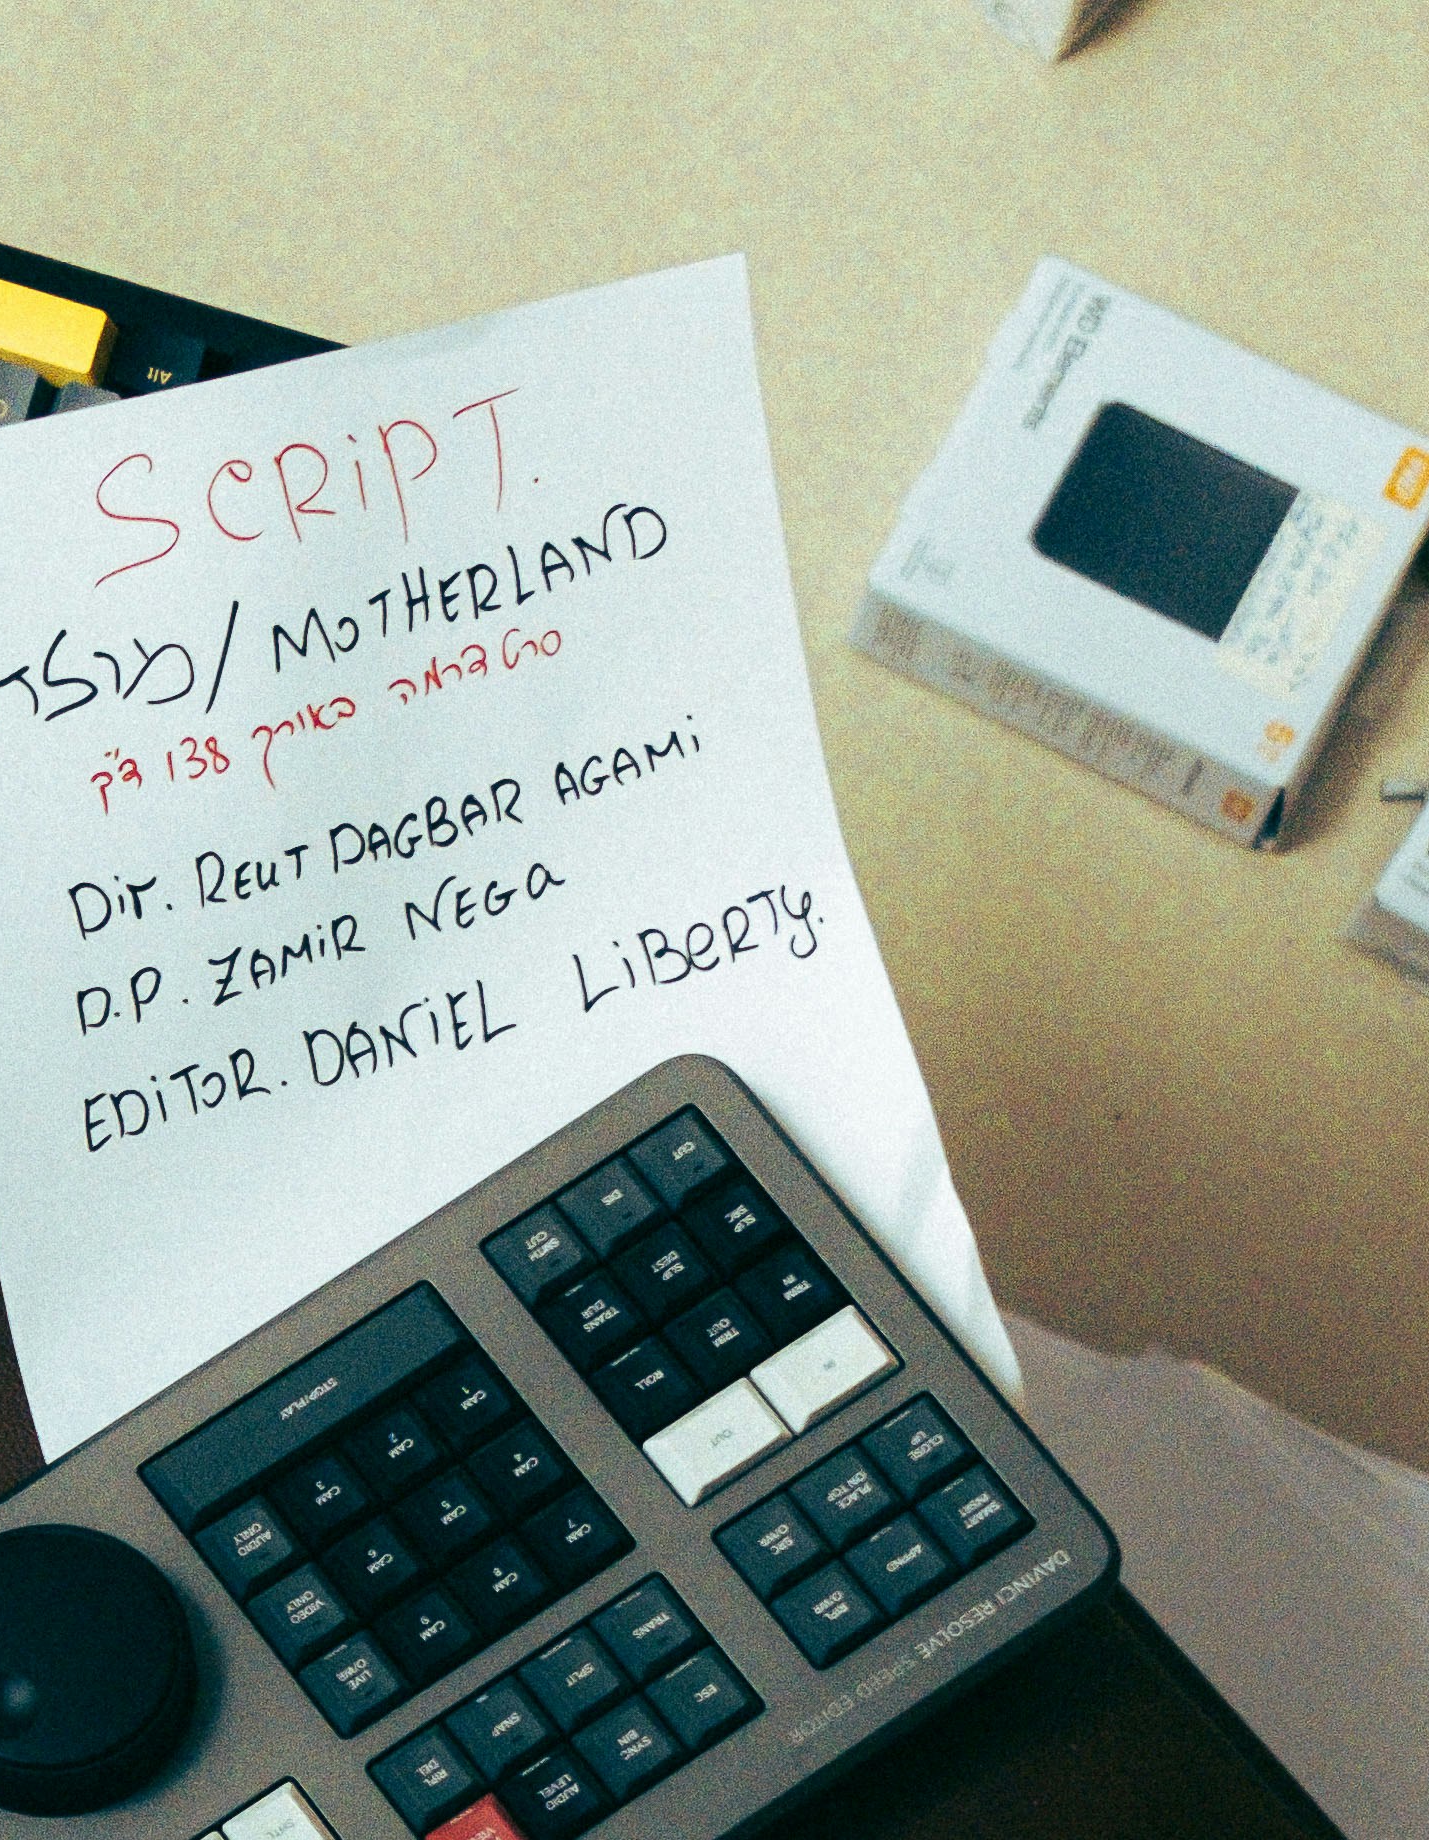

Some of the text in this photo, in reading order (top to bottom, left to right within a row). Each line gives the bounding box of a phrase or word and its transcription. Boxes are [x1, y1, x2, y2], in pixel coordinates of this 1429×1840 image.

[147, 367, 172, 384] Alt
[499, 628, 563, 669] סרט
[386, 639, 487, 710] דרמה
[249, 693, 358, 787] באורך
[164, 736, 233, 787] 138
[328, 776, 524, 878] DAGBAR
[652, 1251, 679, 1272] DEST
[584, 1307, 619, 1331] TRANS
[714, 1328, 739, 1347] TRIM
[635, 1370, 664, 1389] ROLL
[461, 1390, 486, 1410] CAM
[389, 1439, 414, 1458] CAM
[512, 1455, 539, 1478] CAM
[316, 1486, 341, 1505] CAM
[838, 1483, 872, 1508] PLACE
[442, 1505, 467, 1524] CAM
[966, 1501, 1001, 1528] SMART
[234, 1523, 262, 1544] ONLY
[238, 1530, 271, 1556] AUDIO
[566, 1524, 591, 1542] CAM
[368, 1554, 393, 1573] CAM
[494, 1572, 518, 1592] CAM
[284, 1589, 315, 1613] ONLY
[291, 1599, 325, 1623] VIDEO
[420, 1620, 445, 1640] CAM
[633, 1612, 670, 1638] TRANS
[788, 1550, 1071, 1744] DAVINCI RESOLVE SPEED EDITOR
[348, 1670, 372, 1689] LIVE
[567, 1663, 594, 1686] SPLIT
[695, 1684, 718, 1701] ESC
[493, 1712, 520, 1736] SNAP
[621, 1736, 652, 1759] SYNC
[417, 1758, 439, 1776] DEL
[538, 1774, 572, 1797] LEVEL
[546, 1783, 579, 1810] AUDIO
